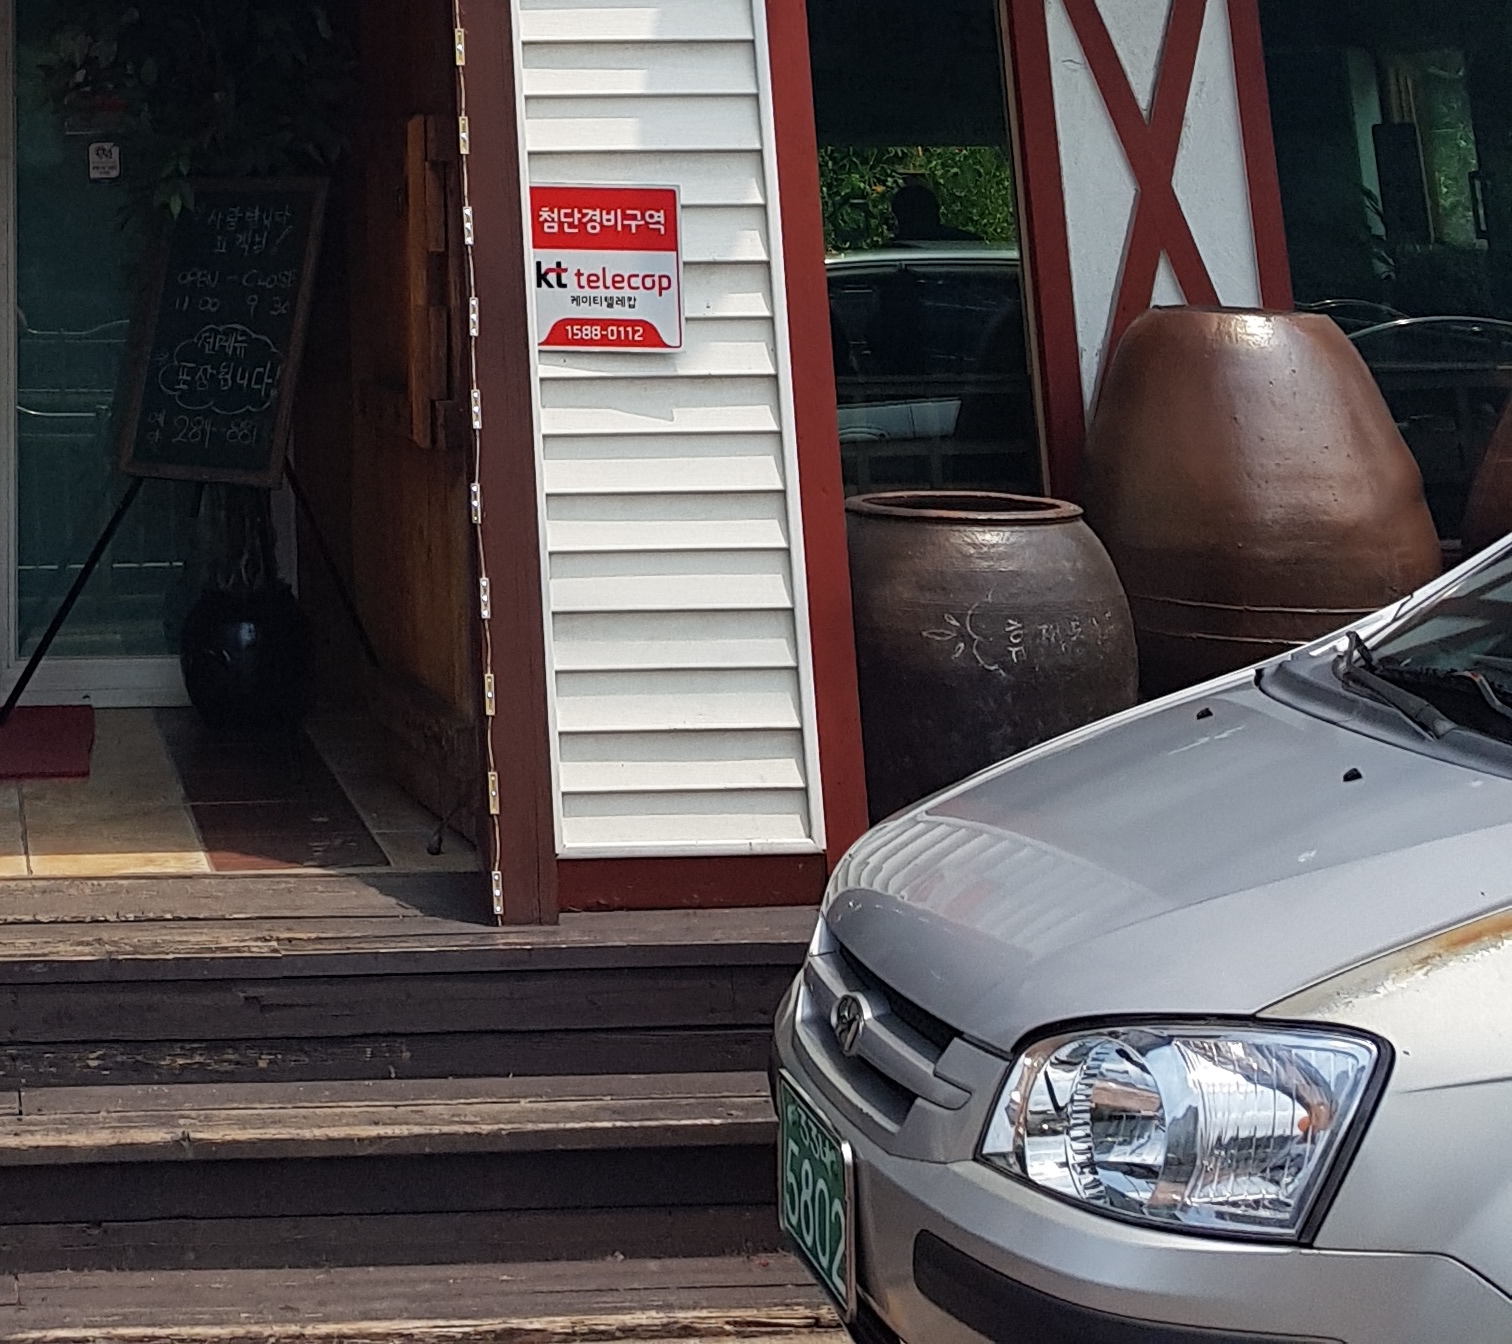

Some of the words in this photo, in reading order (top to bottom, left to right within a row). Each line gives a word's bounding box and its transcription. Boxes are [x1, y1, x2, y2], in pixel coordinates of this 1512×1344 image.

[538, 207, 666, 235] 첨단경비구역
[535, 261, 569, 289] kt
[574, 266, 672, 298] telecop
[570, 295, 637, 309] 케이티텔레캅
[565, 324, 644, 341] 1588-0112
[785, 1138, 846, 1300] 5802
